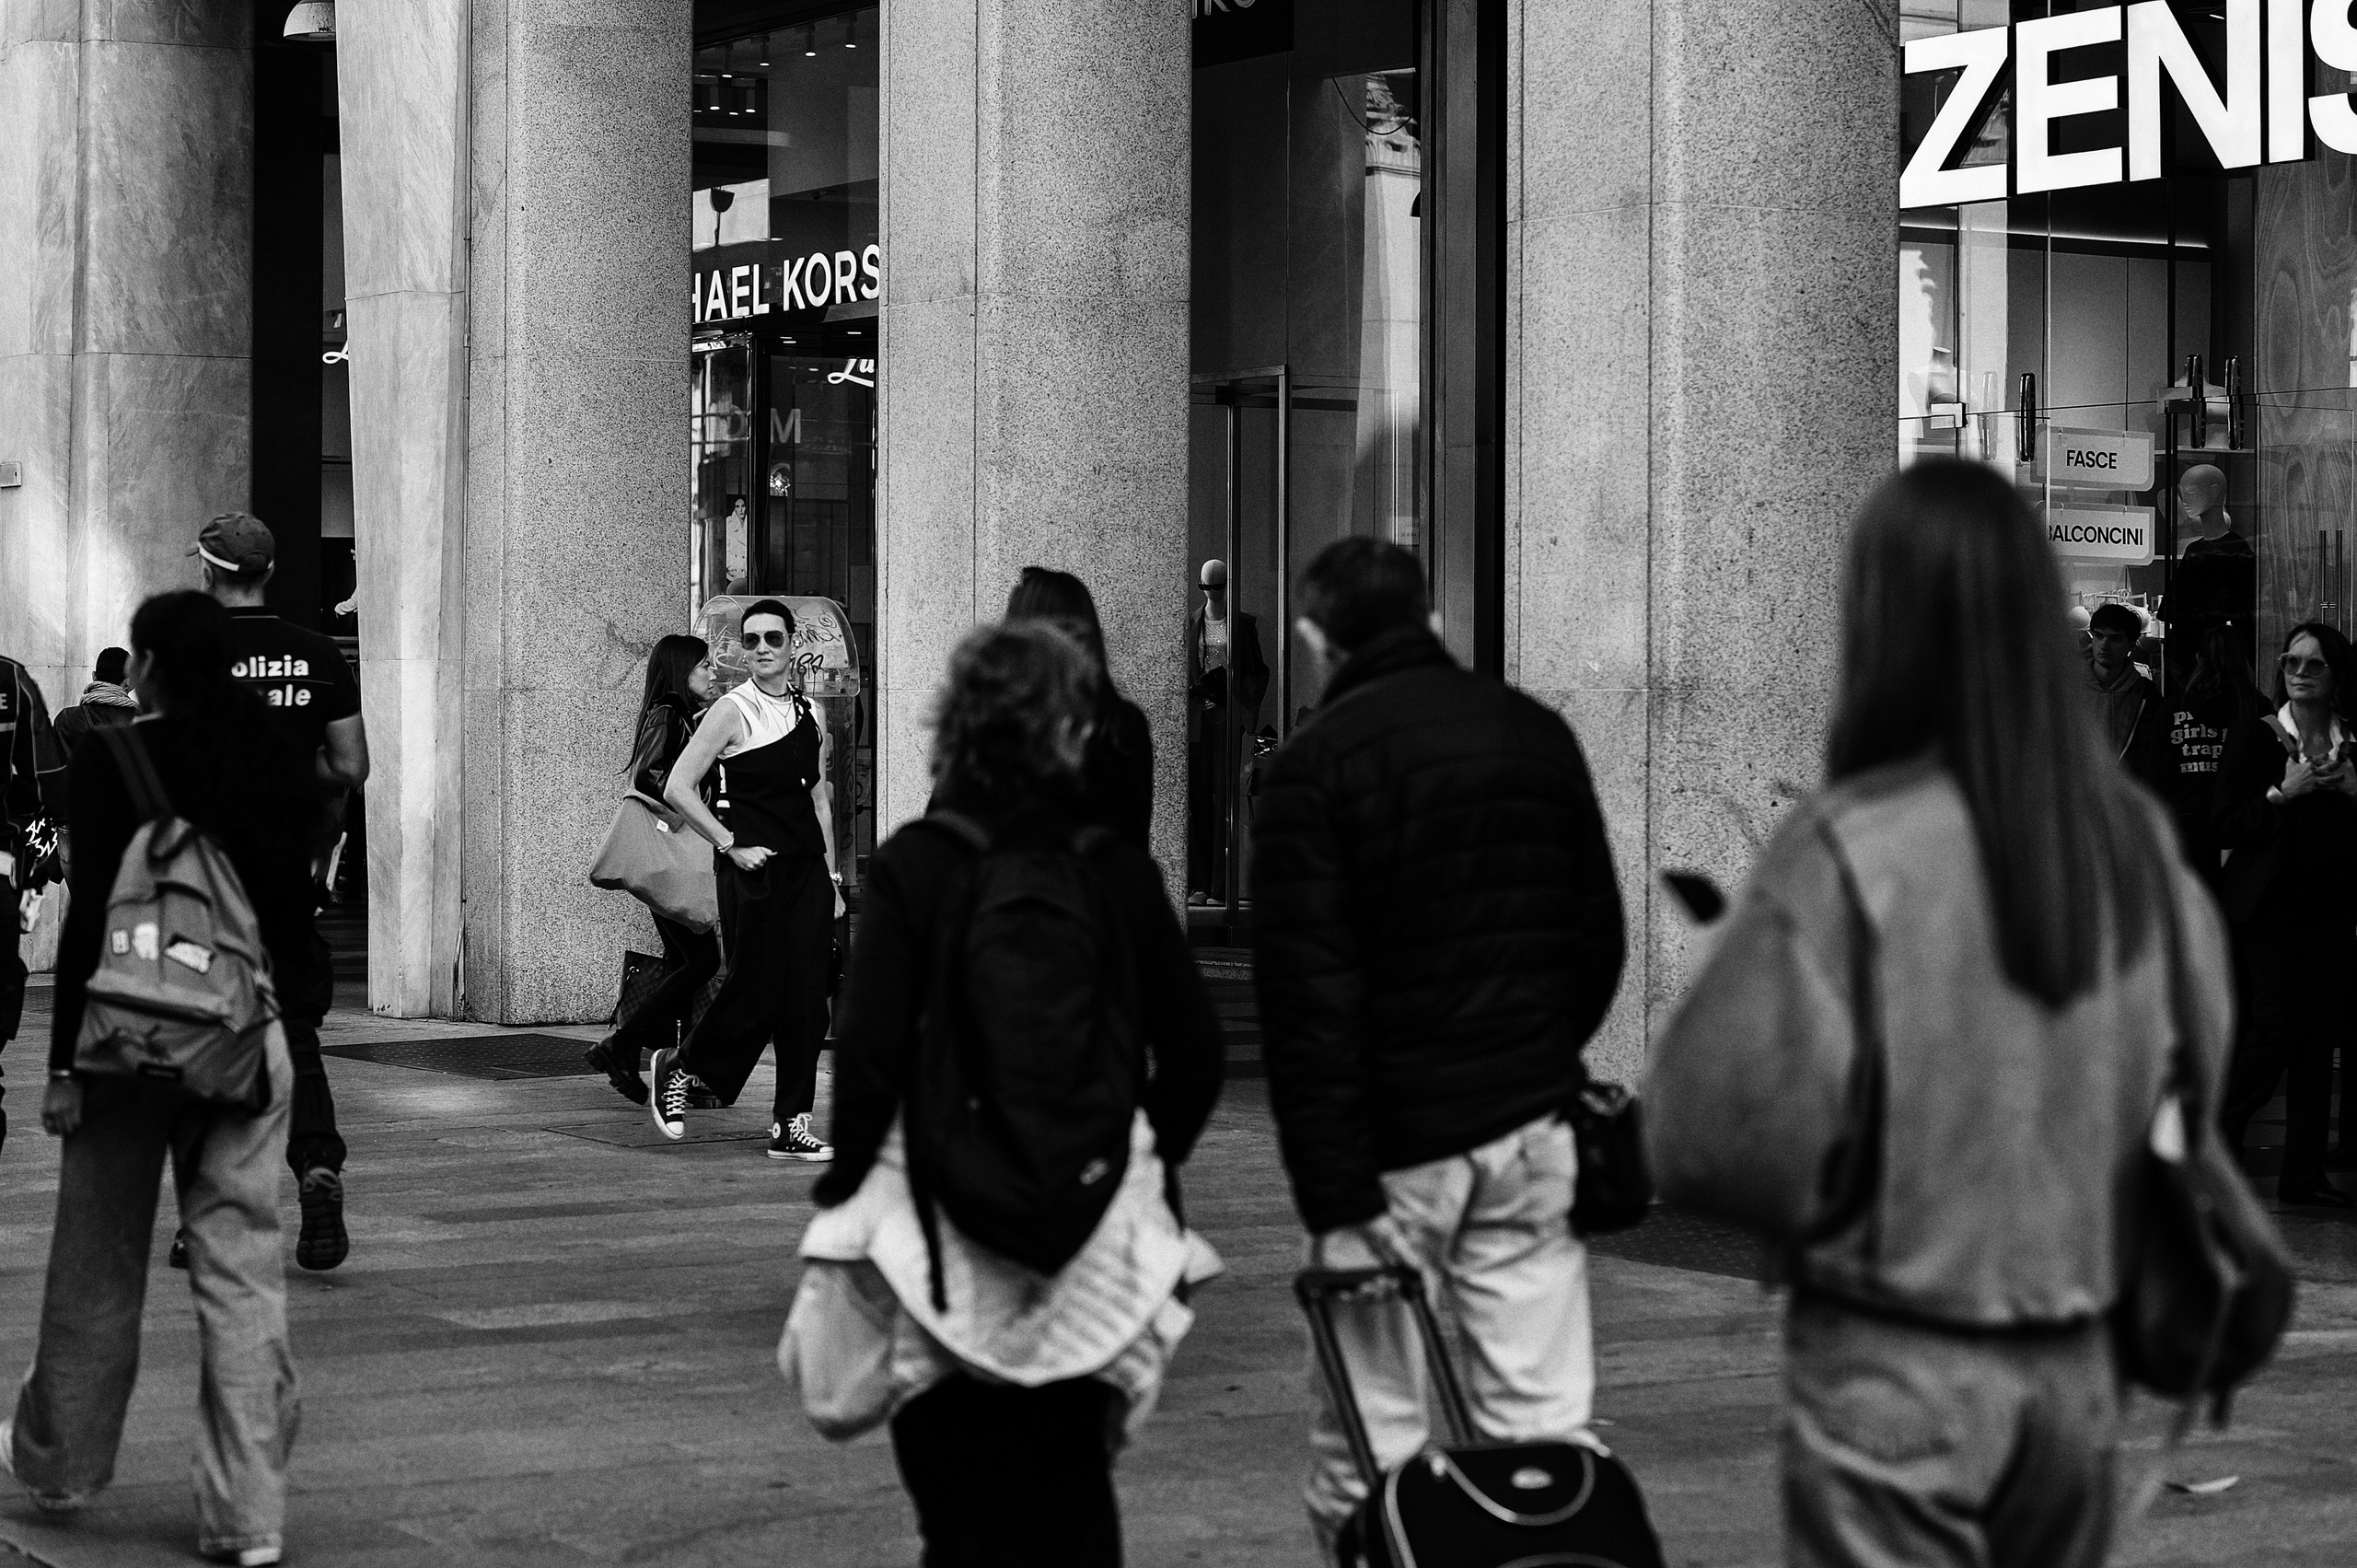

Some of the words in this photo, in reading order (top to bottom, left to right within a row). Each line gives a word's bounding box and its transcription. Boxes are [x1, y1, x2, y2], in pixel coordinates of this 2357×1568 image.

[783, 244, 879, 311] KORS
[2066, 449, 2118, 470] FASCE
[231, 655, 309, 678] olizia
[2170, 724, 2218, 744] girls
[2182, 743, 2223, 758] trap
[2179, 761, 2219, 772] mus
